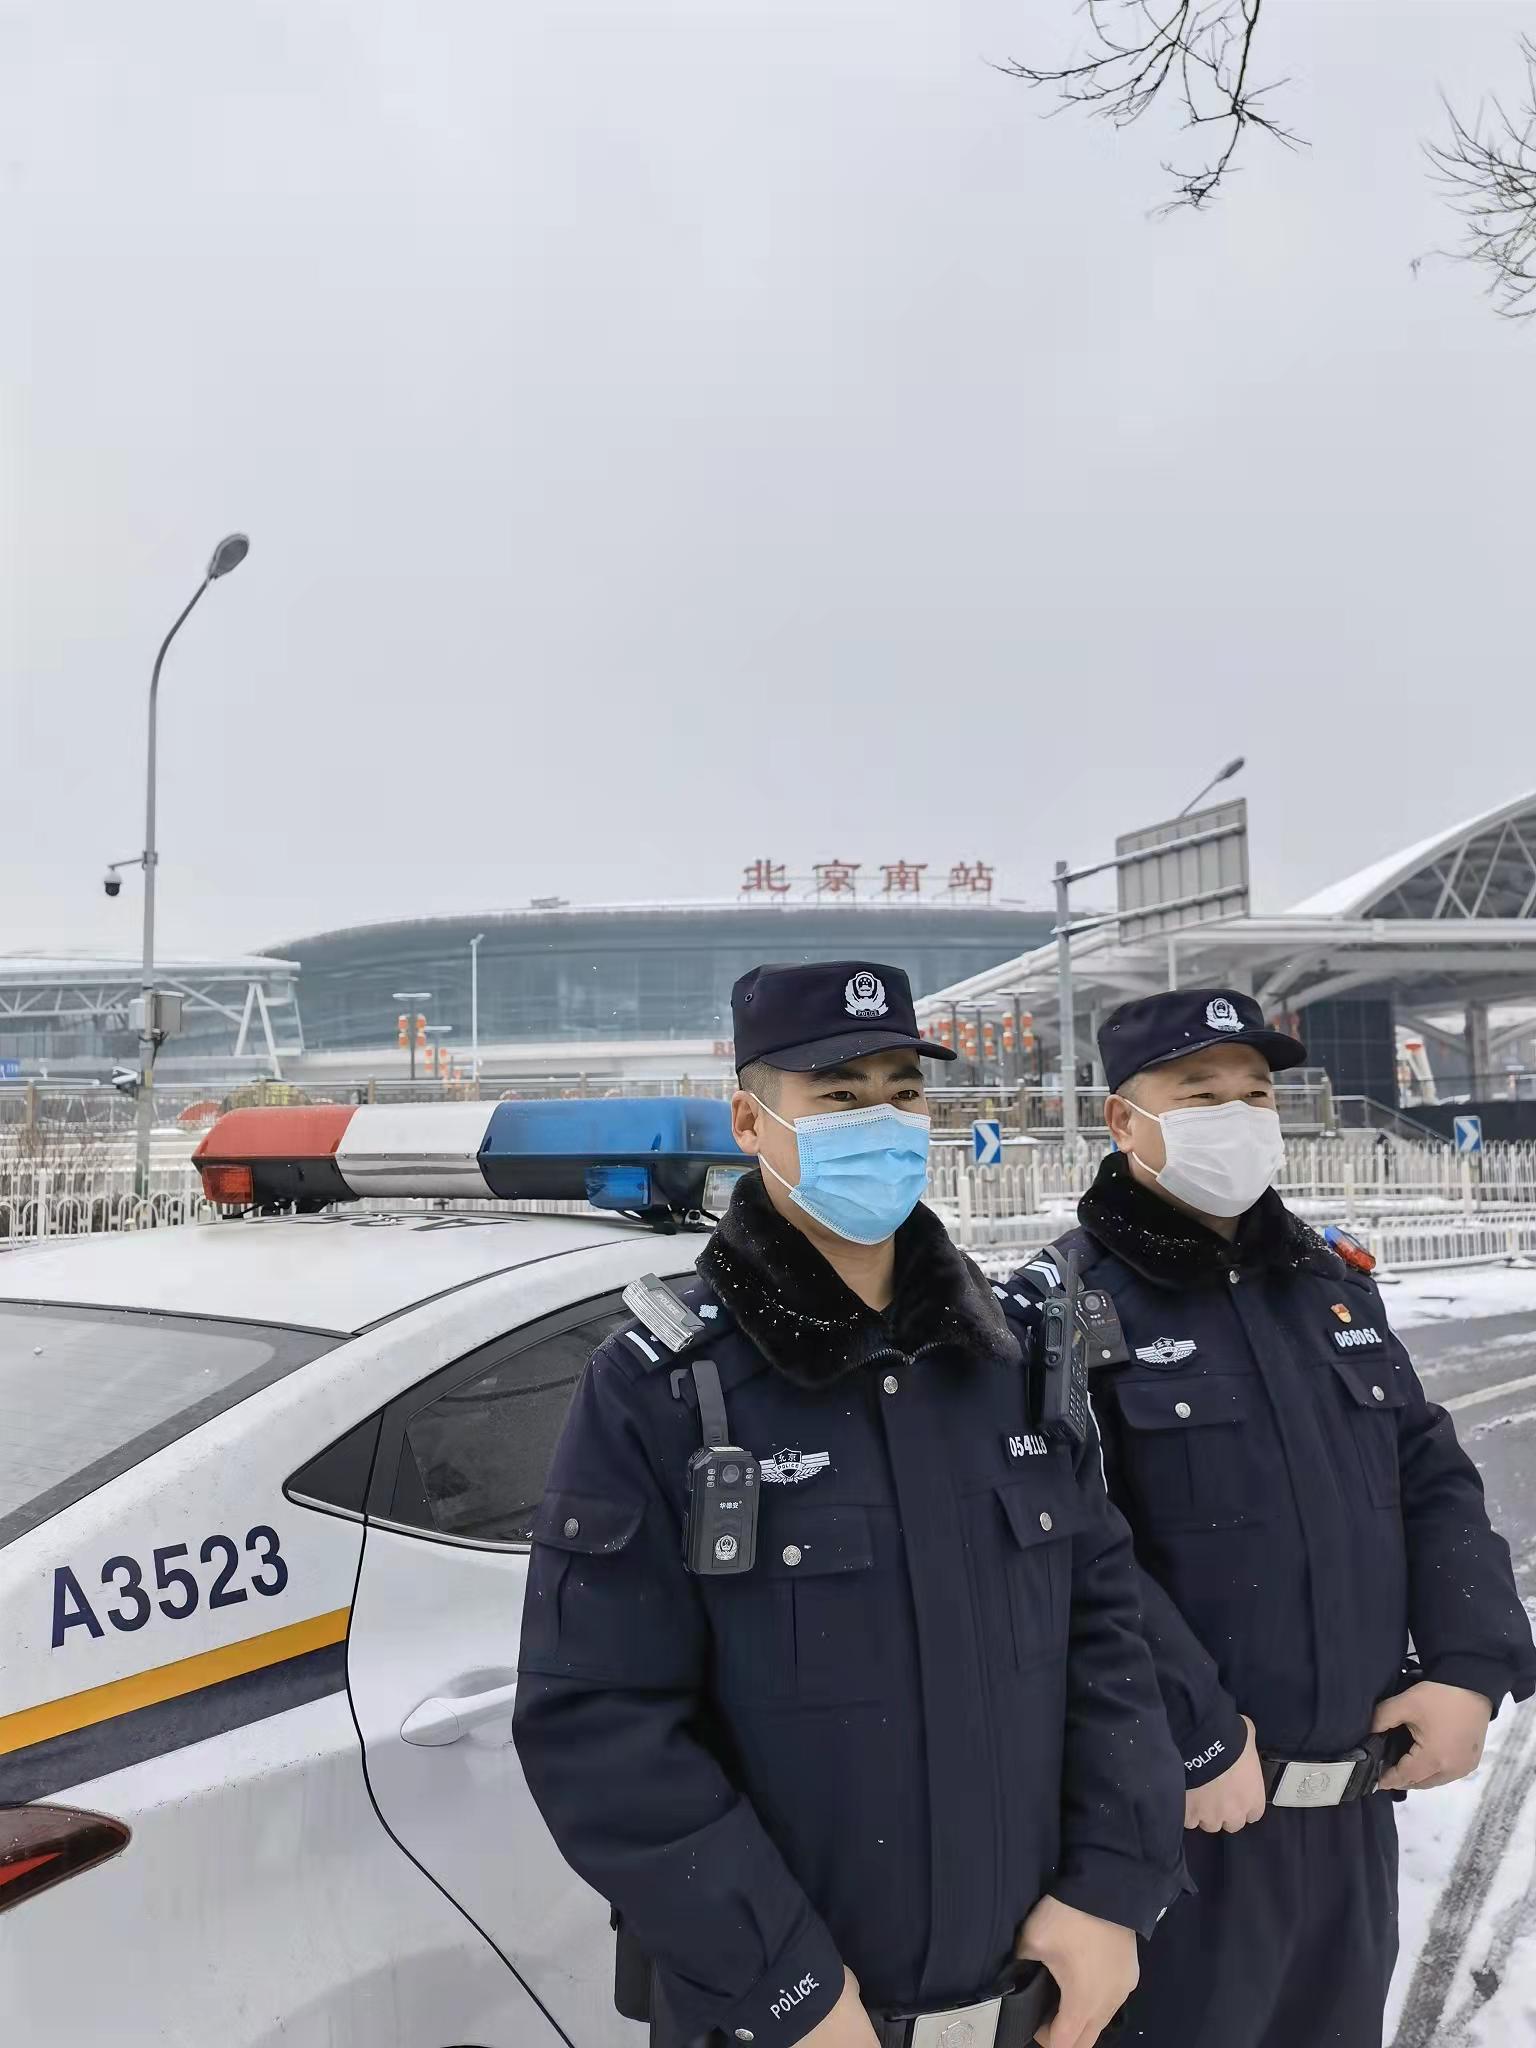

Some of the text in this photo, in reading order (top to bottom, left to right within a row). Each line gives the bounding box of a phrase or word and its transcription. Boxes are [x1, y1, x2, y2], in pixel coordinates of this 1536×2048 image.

[741, 859, 994, 892] 北京南站
[656, 1293, 681, 1317] POLICE
[1334, 1327, 1382, 1348] 068061
[777, 1463, 800, 1471] POLICE
[779, 1453, 797, 1462] 北京
[51, 1525, 289, 1649] A3523
[1184, 1740, 1225, 1771] POLICE
[770, 1972, 820, 2019] POLICE
